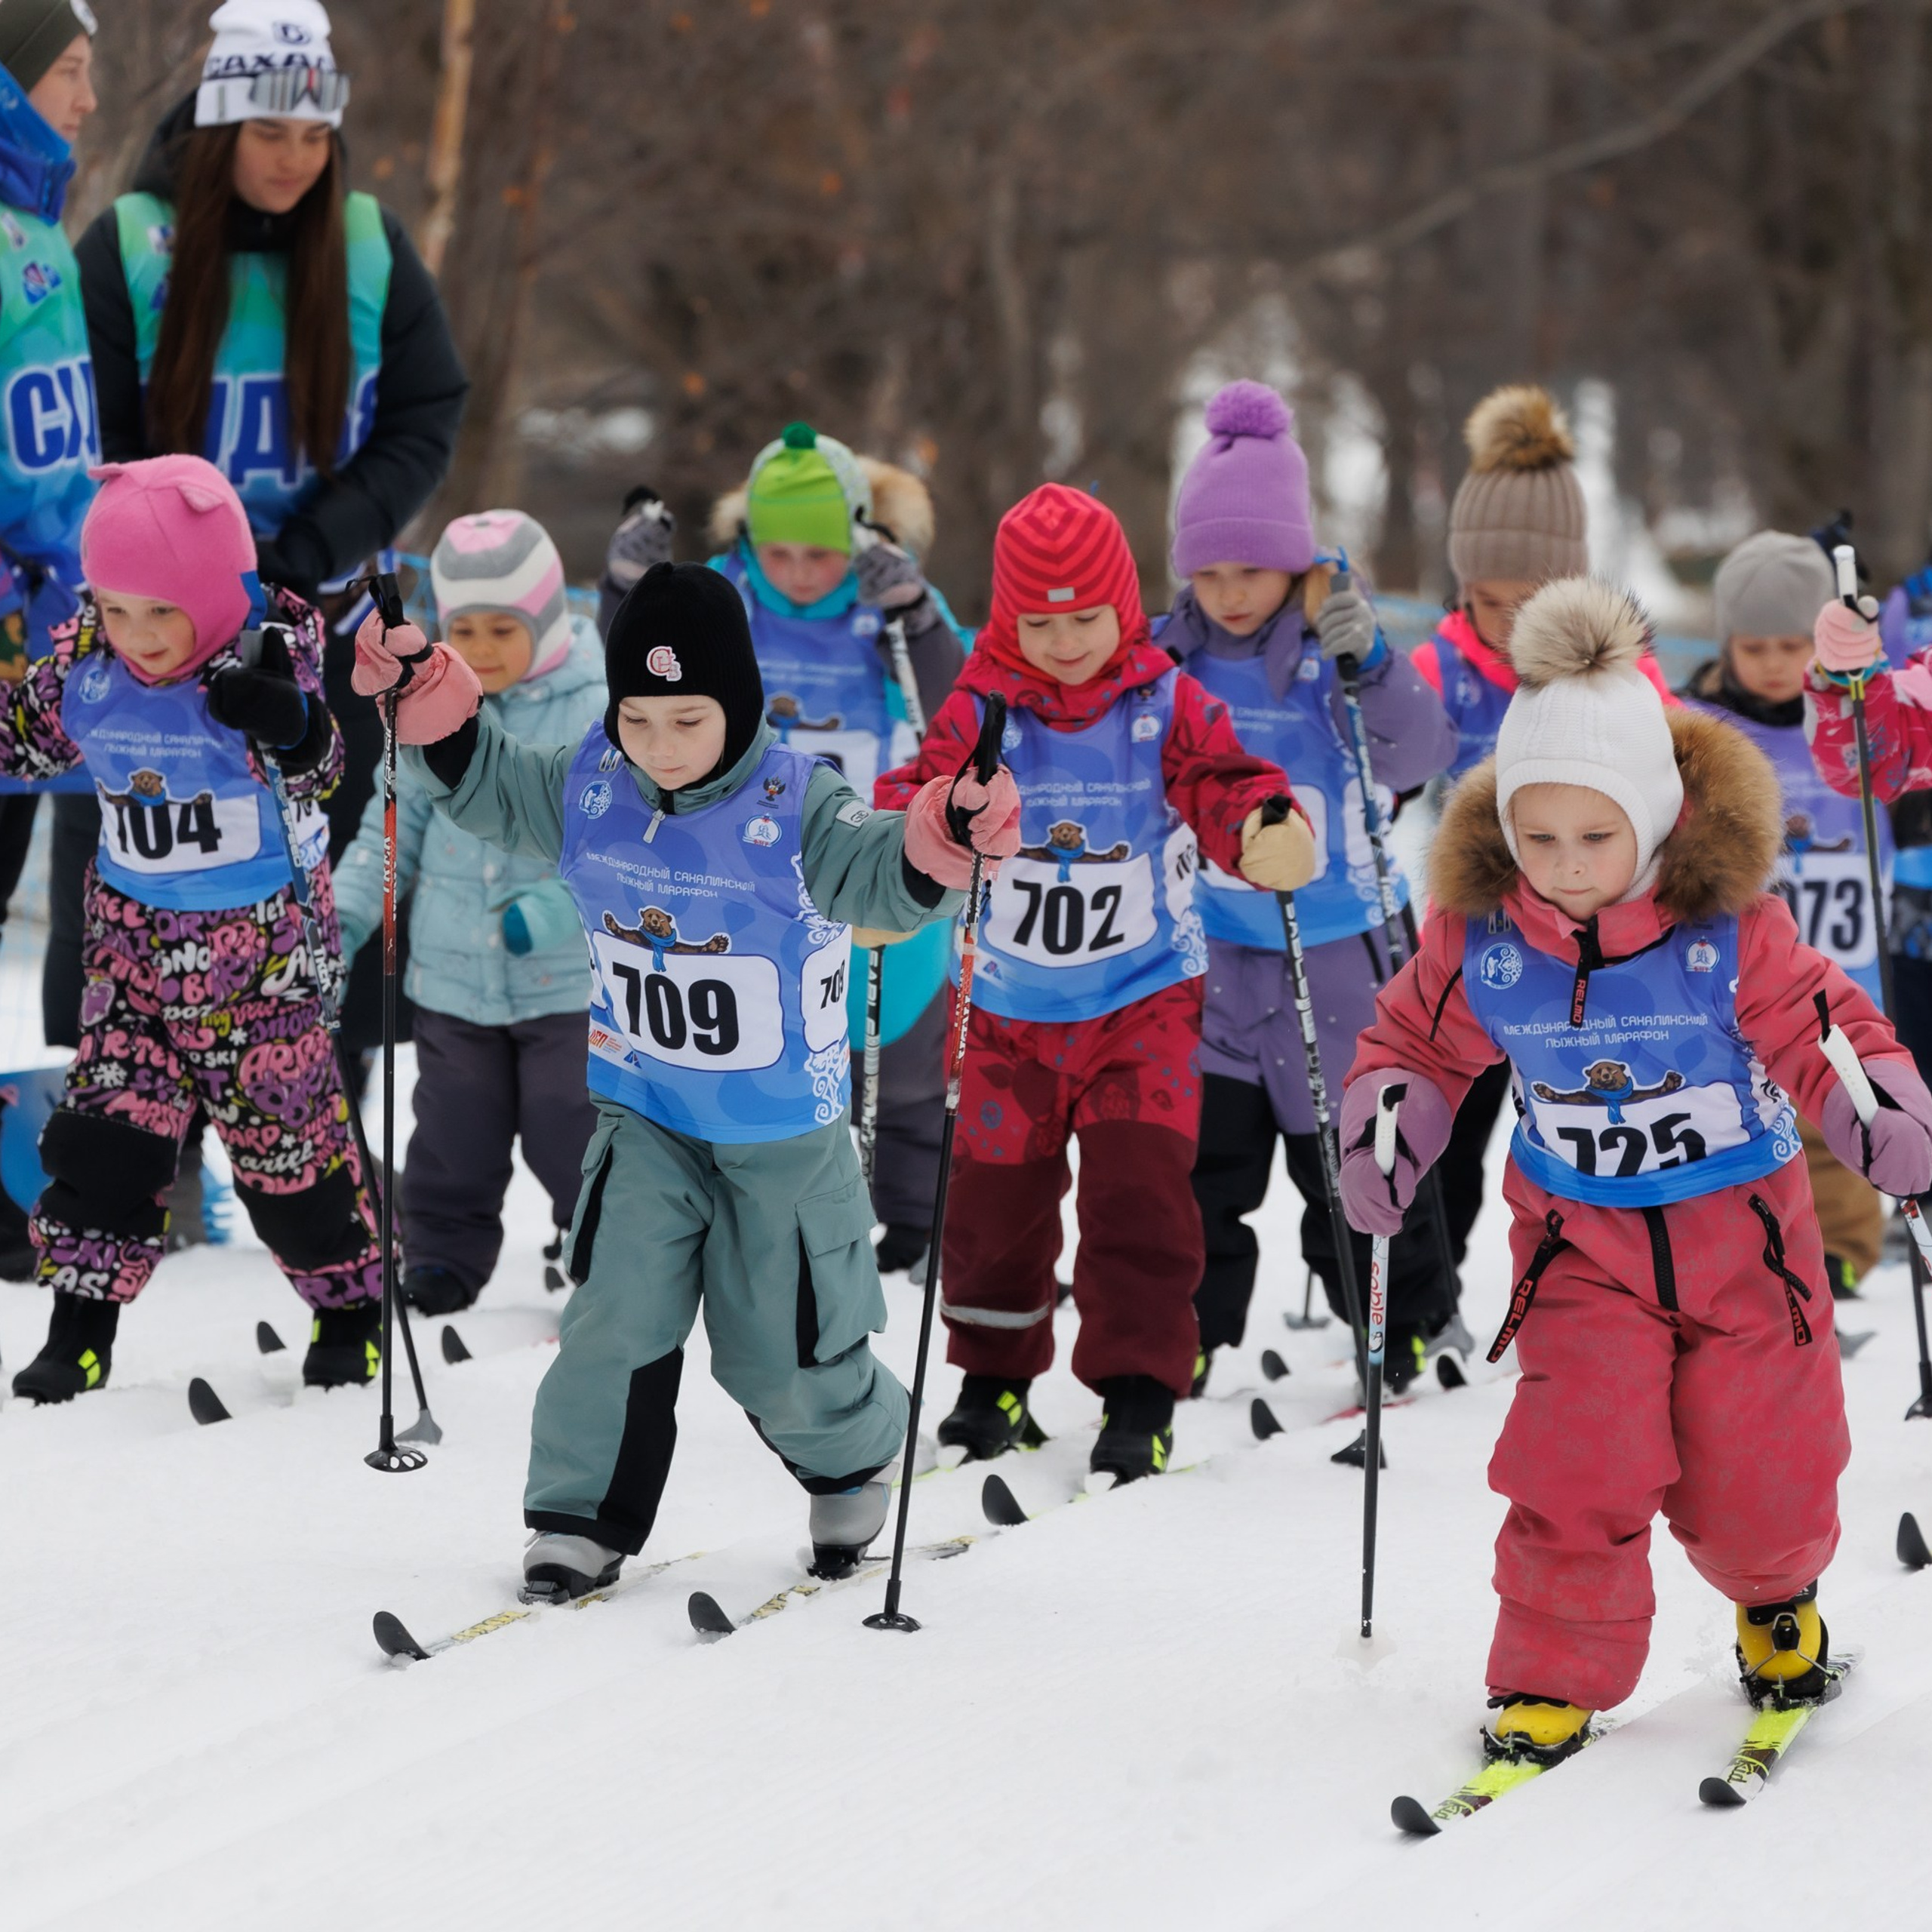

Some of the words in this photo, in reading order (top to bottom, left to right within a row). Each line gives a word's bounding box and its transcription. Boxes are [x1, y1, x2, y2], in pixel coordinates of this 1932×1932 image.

[586, 851, 671, 880] МЕЖДУНАРОДНЫЙ
[673, 869, 756, 894] САХАЛИНСКИЙ
[617, 872, 654, 893] ЛЫЖНЫЙ
[657, 882, 718, 899] МАРАФОН
[1012, 878, 1125, 955] 702
[612, 961, 740, 1056] 709
[1503, 1014, 1617, 1037] МЕЖДУНАРДНЫЙ
[1620, 1012, 1709, 1029] САХАЛИНСКИЙ
[1572, 978, 1587, 1024] RELMO
[1545, 1031, 1601, 1049] ЛЫЖНЫЙ
[1604, 1029, 1669, 1047] МАРАФОН
[1555, 1112, 1708, 1178] 725
[1491, 1278, 1534, 1363] RELMO
[1784, 1283, 1807, 1346] LMO
